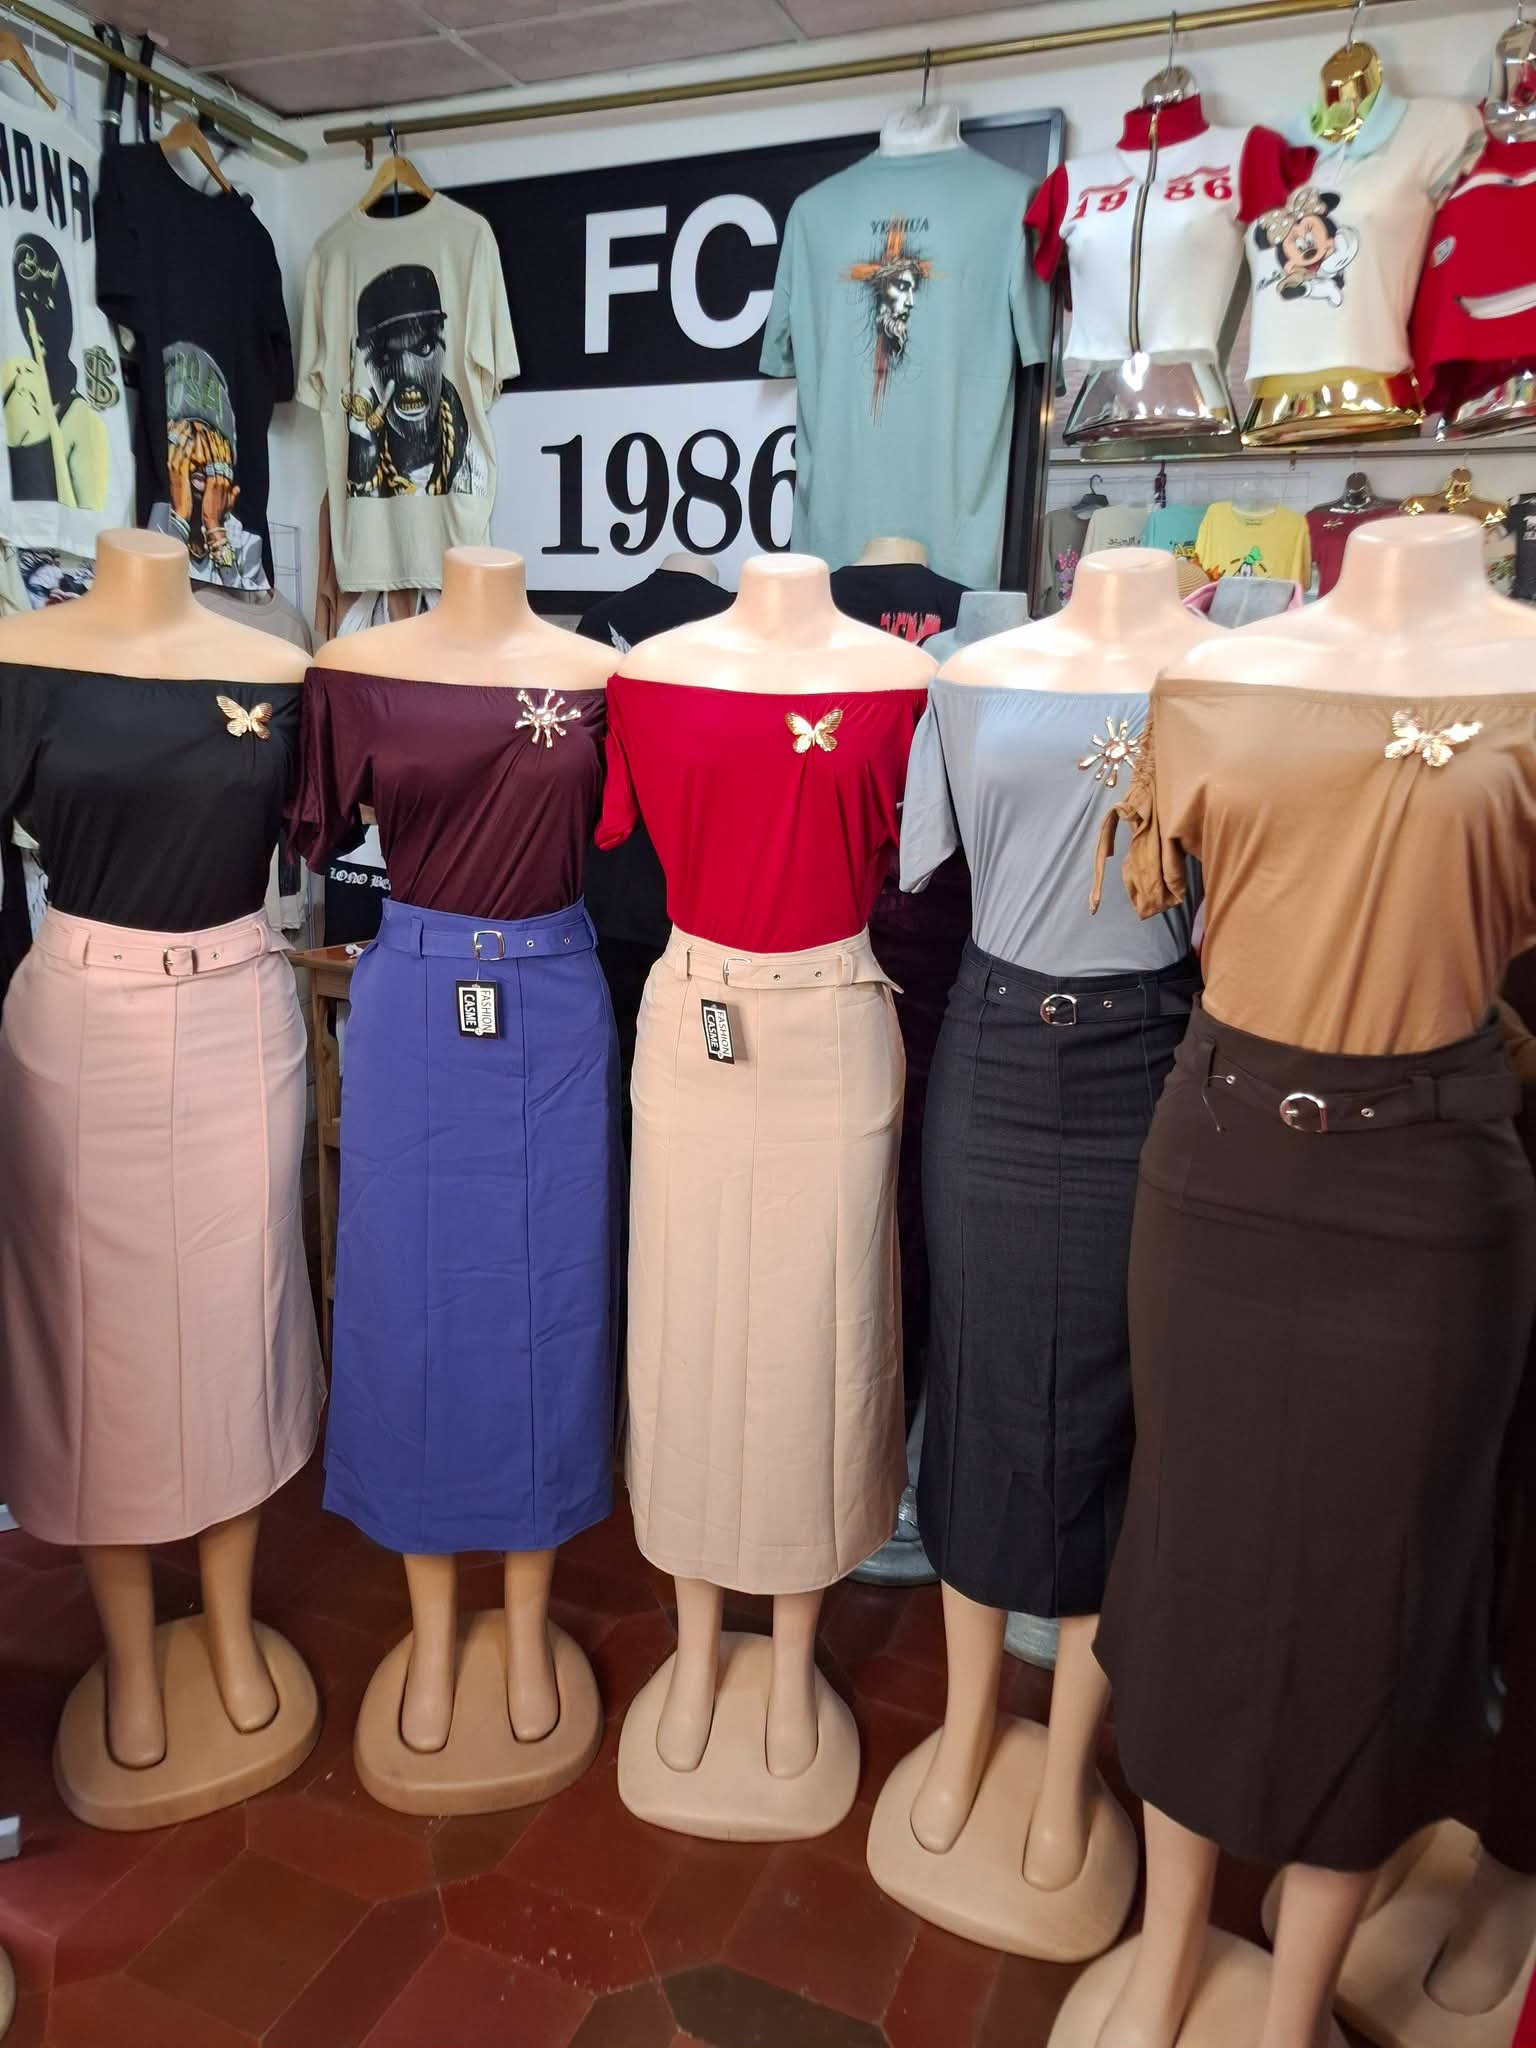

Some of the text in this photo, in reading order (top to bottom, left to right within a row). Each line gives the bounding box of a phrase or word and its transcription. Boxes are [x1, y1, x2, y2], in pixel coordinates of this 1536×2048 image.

[585, 193, 778, 354] FC
[541, 425, 797, 556] 1986
[463, 994, 477, 1026] CASME
[480, 990, 493, 1031] FASHION
[707, 1014, 719, 1049] CASME
[717, 1011, 731, 1055] FASHION
